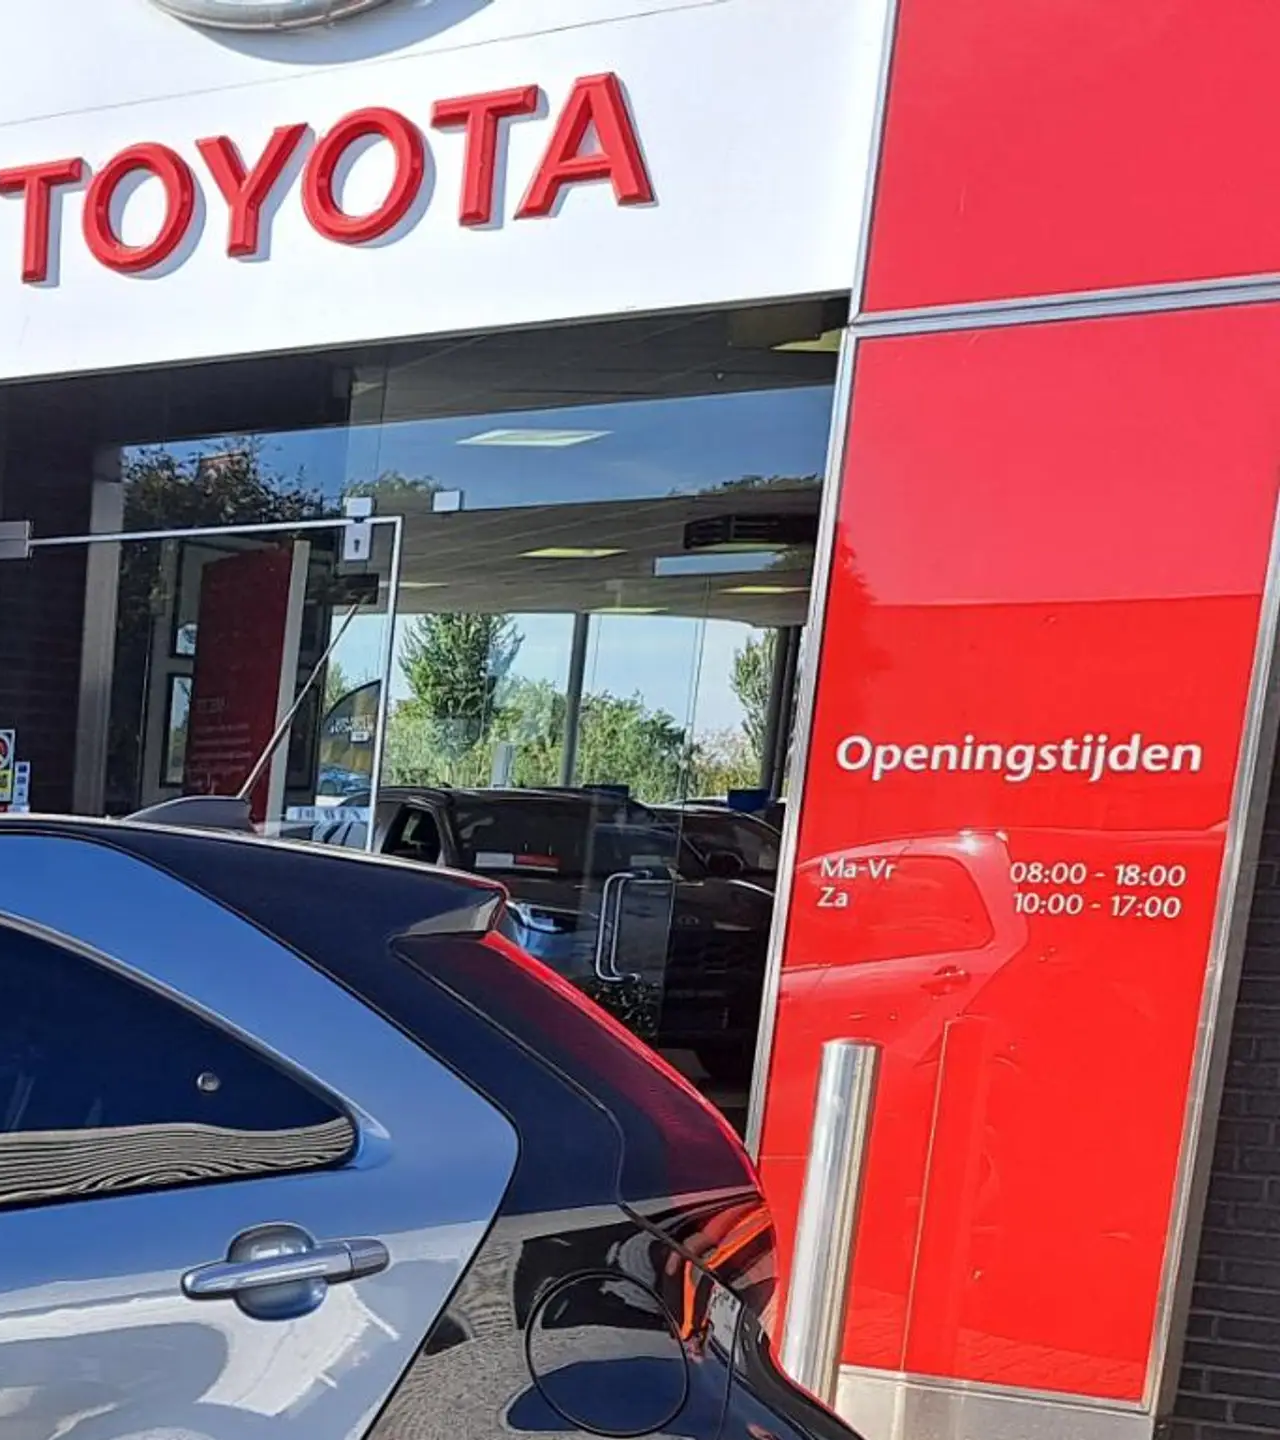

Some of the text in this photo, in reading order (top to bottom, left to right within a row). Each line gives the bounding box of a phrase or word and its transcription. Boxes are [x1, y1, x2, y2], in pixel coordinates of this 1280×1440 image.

[835, 733, 1203, 783] Openingstijden
[819, 857, 897, 881] Ma-Vr
[1009, 861, 1087, 885] 08:00
[1114, 863, 1187, 888] 18:00
[817, 886, 848, 908] Za
[1013, 891, 1083, 915] 10:00
[1110, 894, 1182, 919] 17:00
